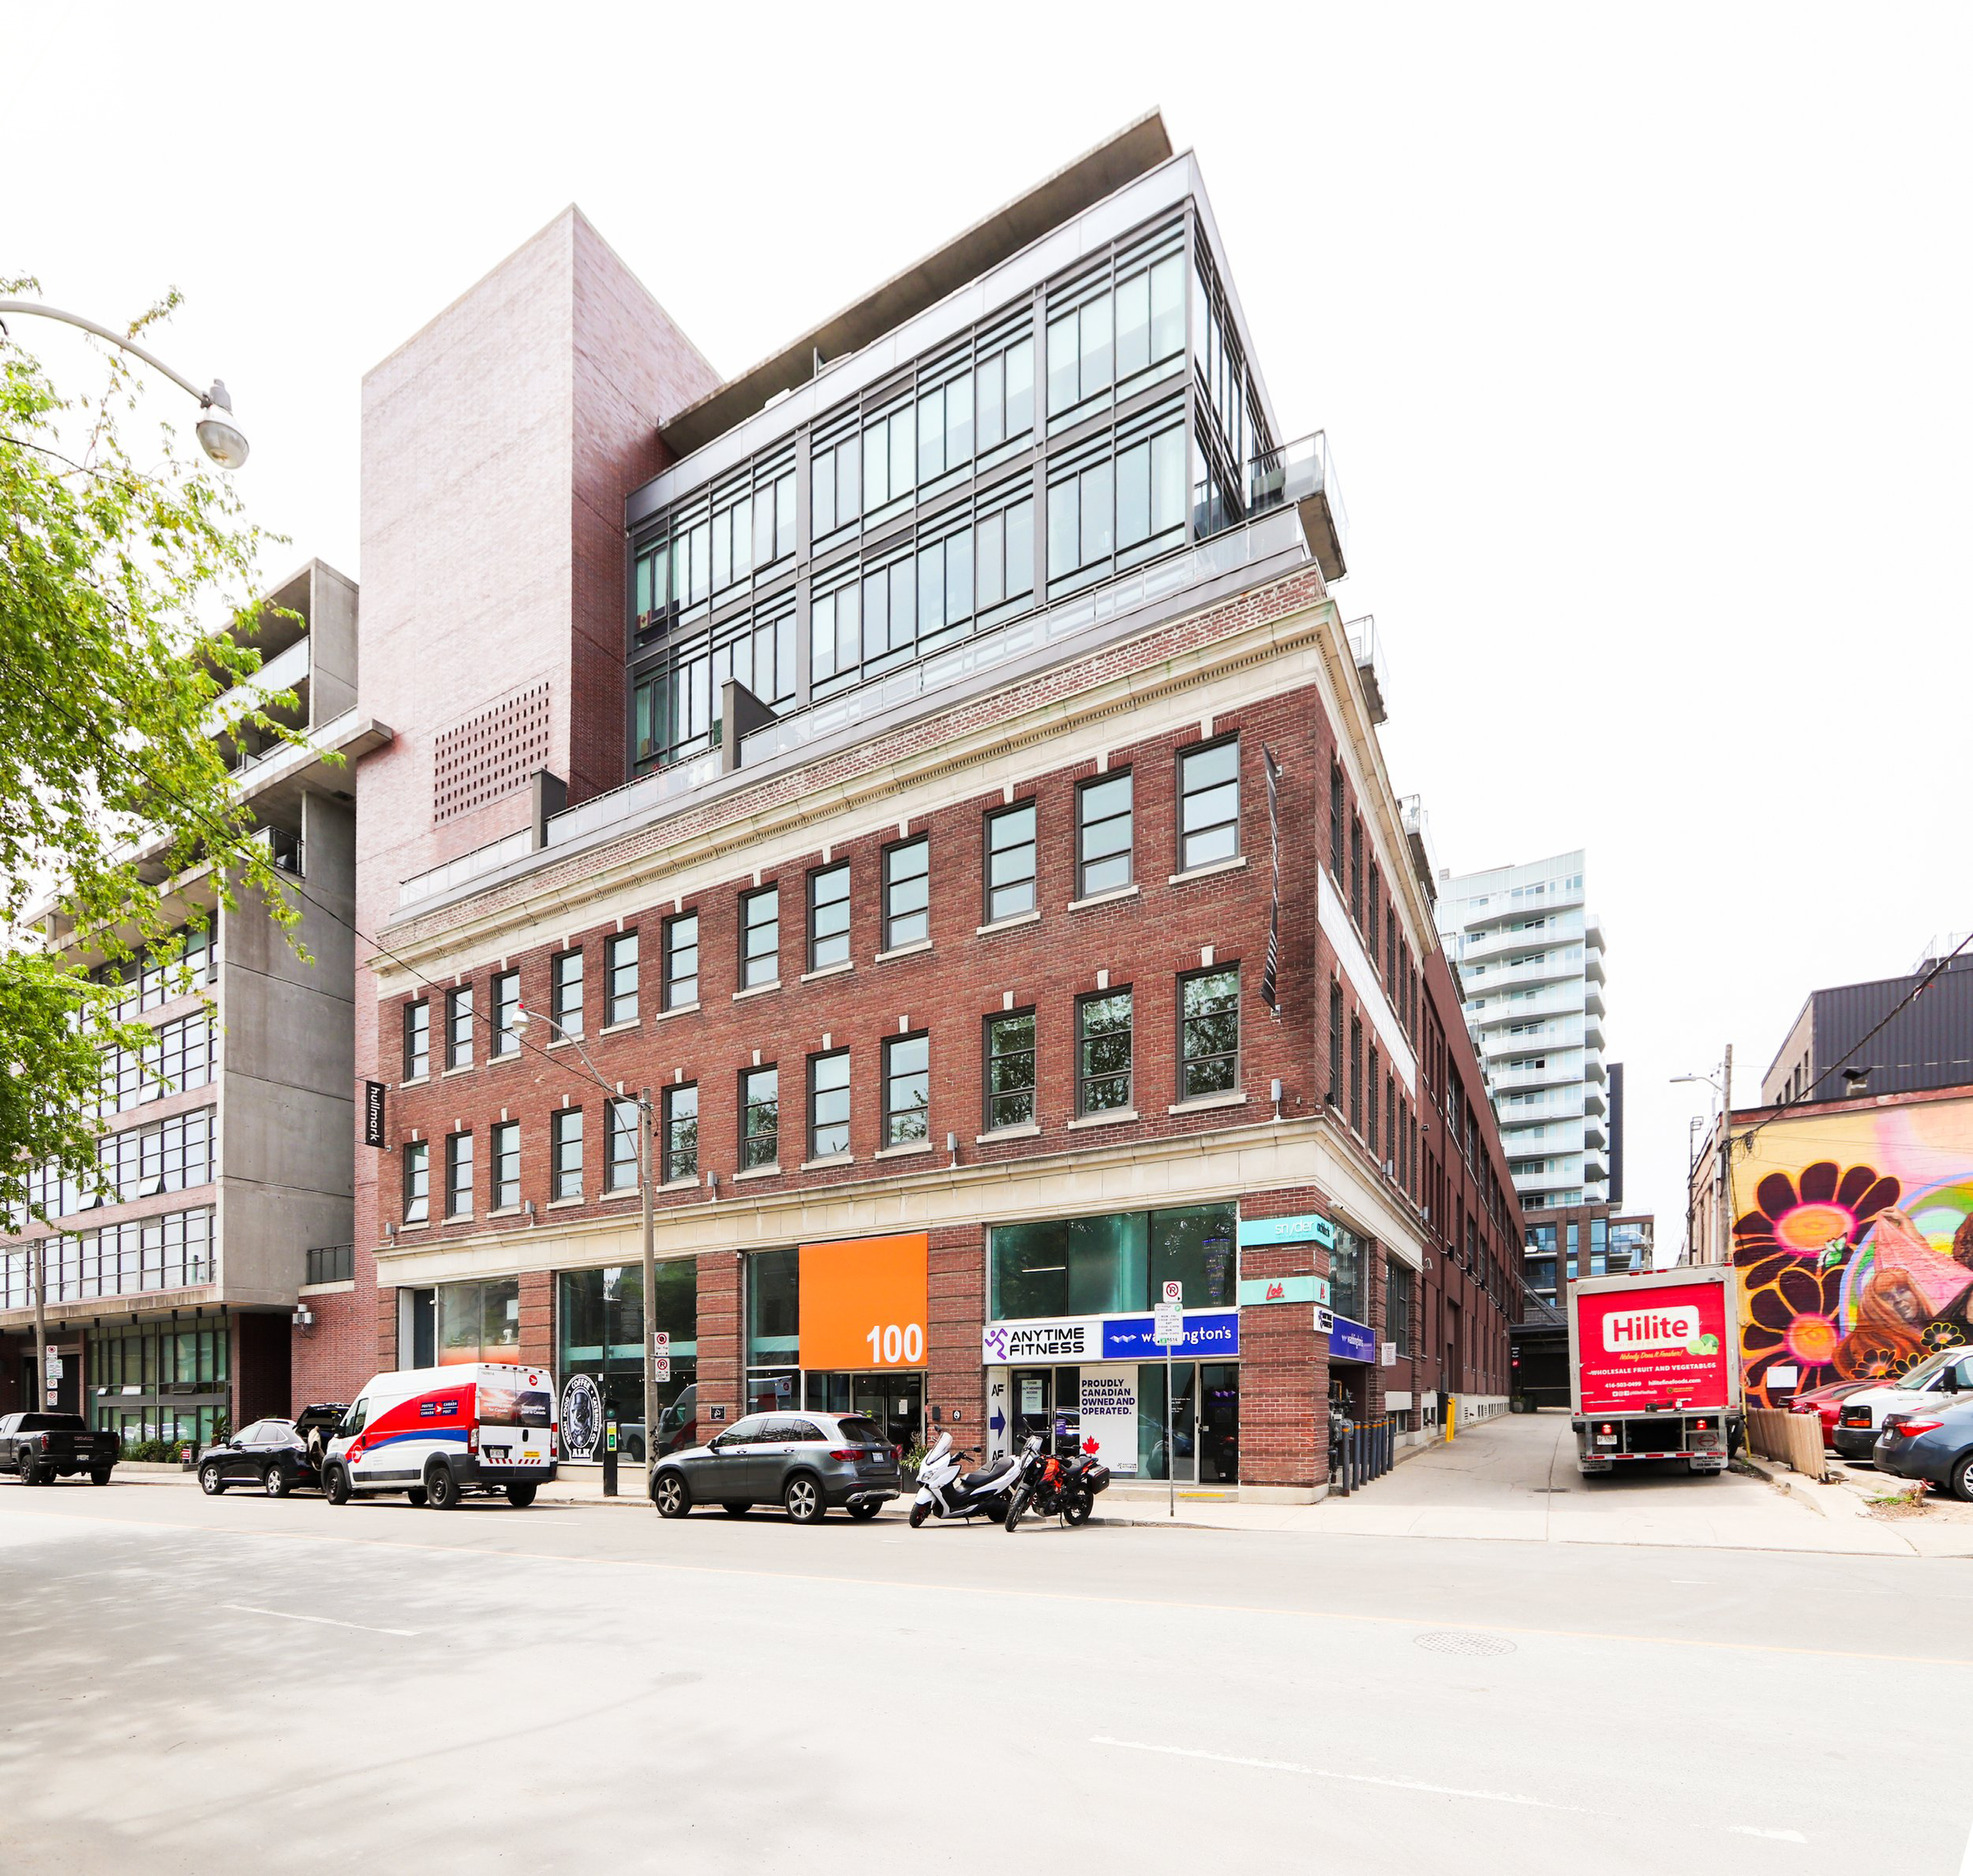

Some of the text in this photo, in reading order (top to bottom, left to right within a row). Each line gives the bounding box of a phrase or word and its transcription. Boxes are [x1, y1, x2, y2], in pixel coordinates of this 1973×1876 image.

[371, 1086, 380, 1141] hullmark
[1275, 1219, 1314, 1236] snyder
[1011, 1327, 1084, 1342] ANYTIME
[1613, 1315, 1689, 1342] Hilite
[866, 1324, 922, 1363] 100
[1010, 1342, 1084, 1356] FITNESS
[571, 1379, 591, 1390] COFFEE
[1082, 1379, 1125, 1388] PROUDLY
[1082, 1388, 1131, 1397] CANADIAN
[1082, 1397, 1135, 1406] OWNED AND
[1082, 1407, 1132, 1416] OPERATED.
[563, 1421, 571, 1444] VEGAN
[571, 1449, 590, 1458] ALK
